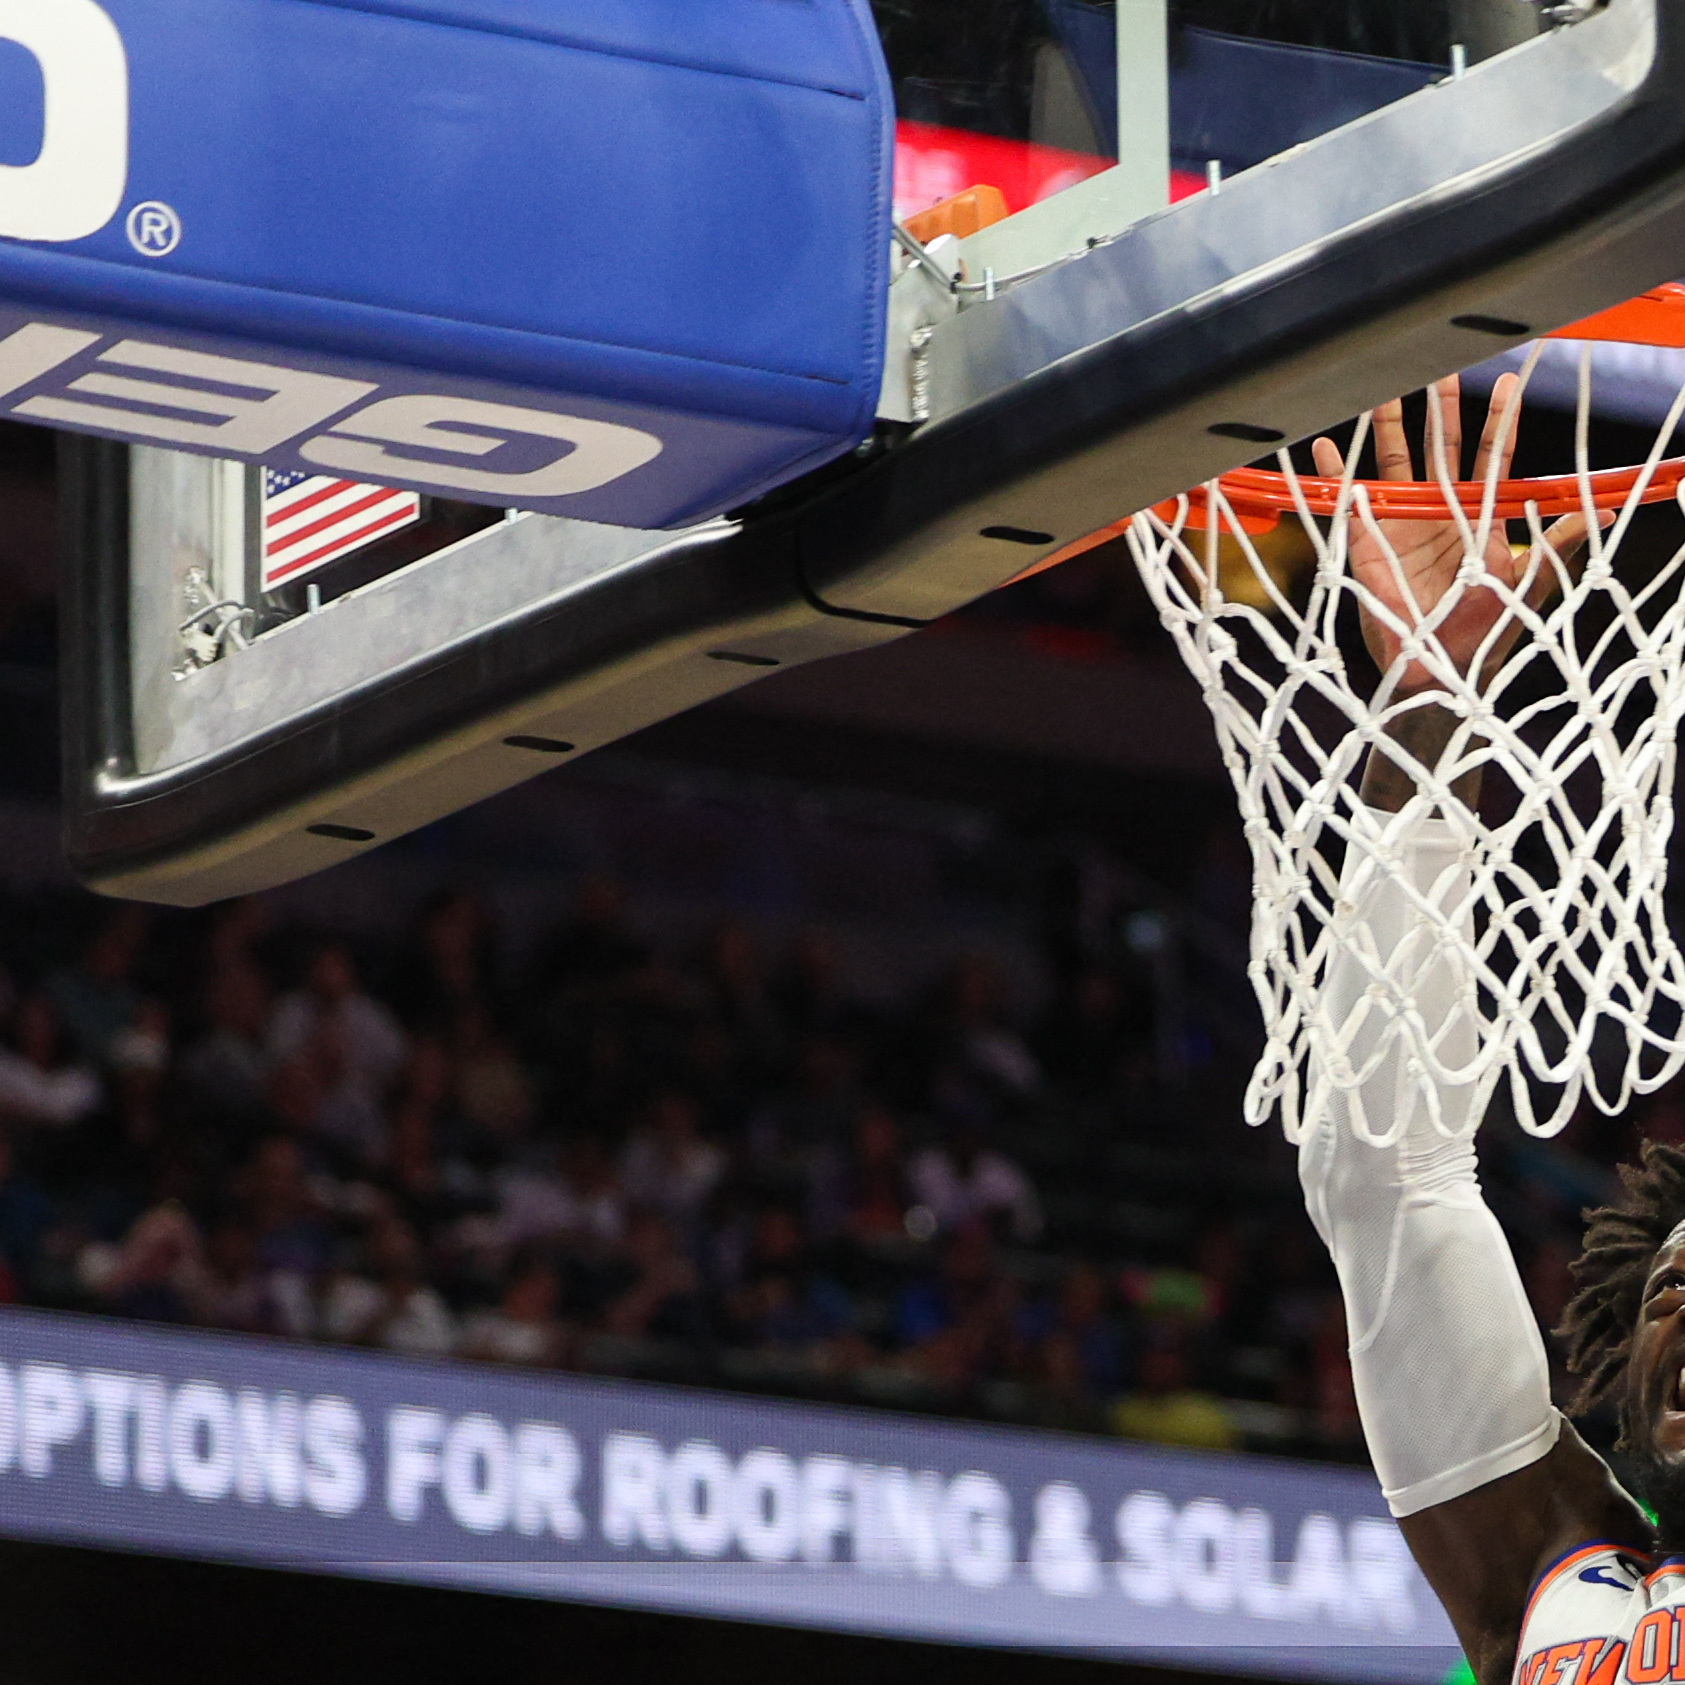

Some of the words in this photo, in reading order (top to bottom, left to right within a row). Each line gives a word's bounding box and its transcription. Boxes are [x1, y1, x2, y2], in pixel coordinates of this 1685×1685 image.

[0, 1358, 368, 1518] PTIONS
[387, 1403, 586, 1540] FOR
[602, 1428, 1014, 1590] ROOFING
[1029, 1479, 1100, 1599] &
[1115, 1489, 1415, 1635] SOLAR
